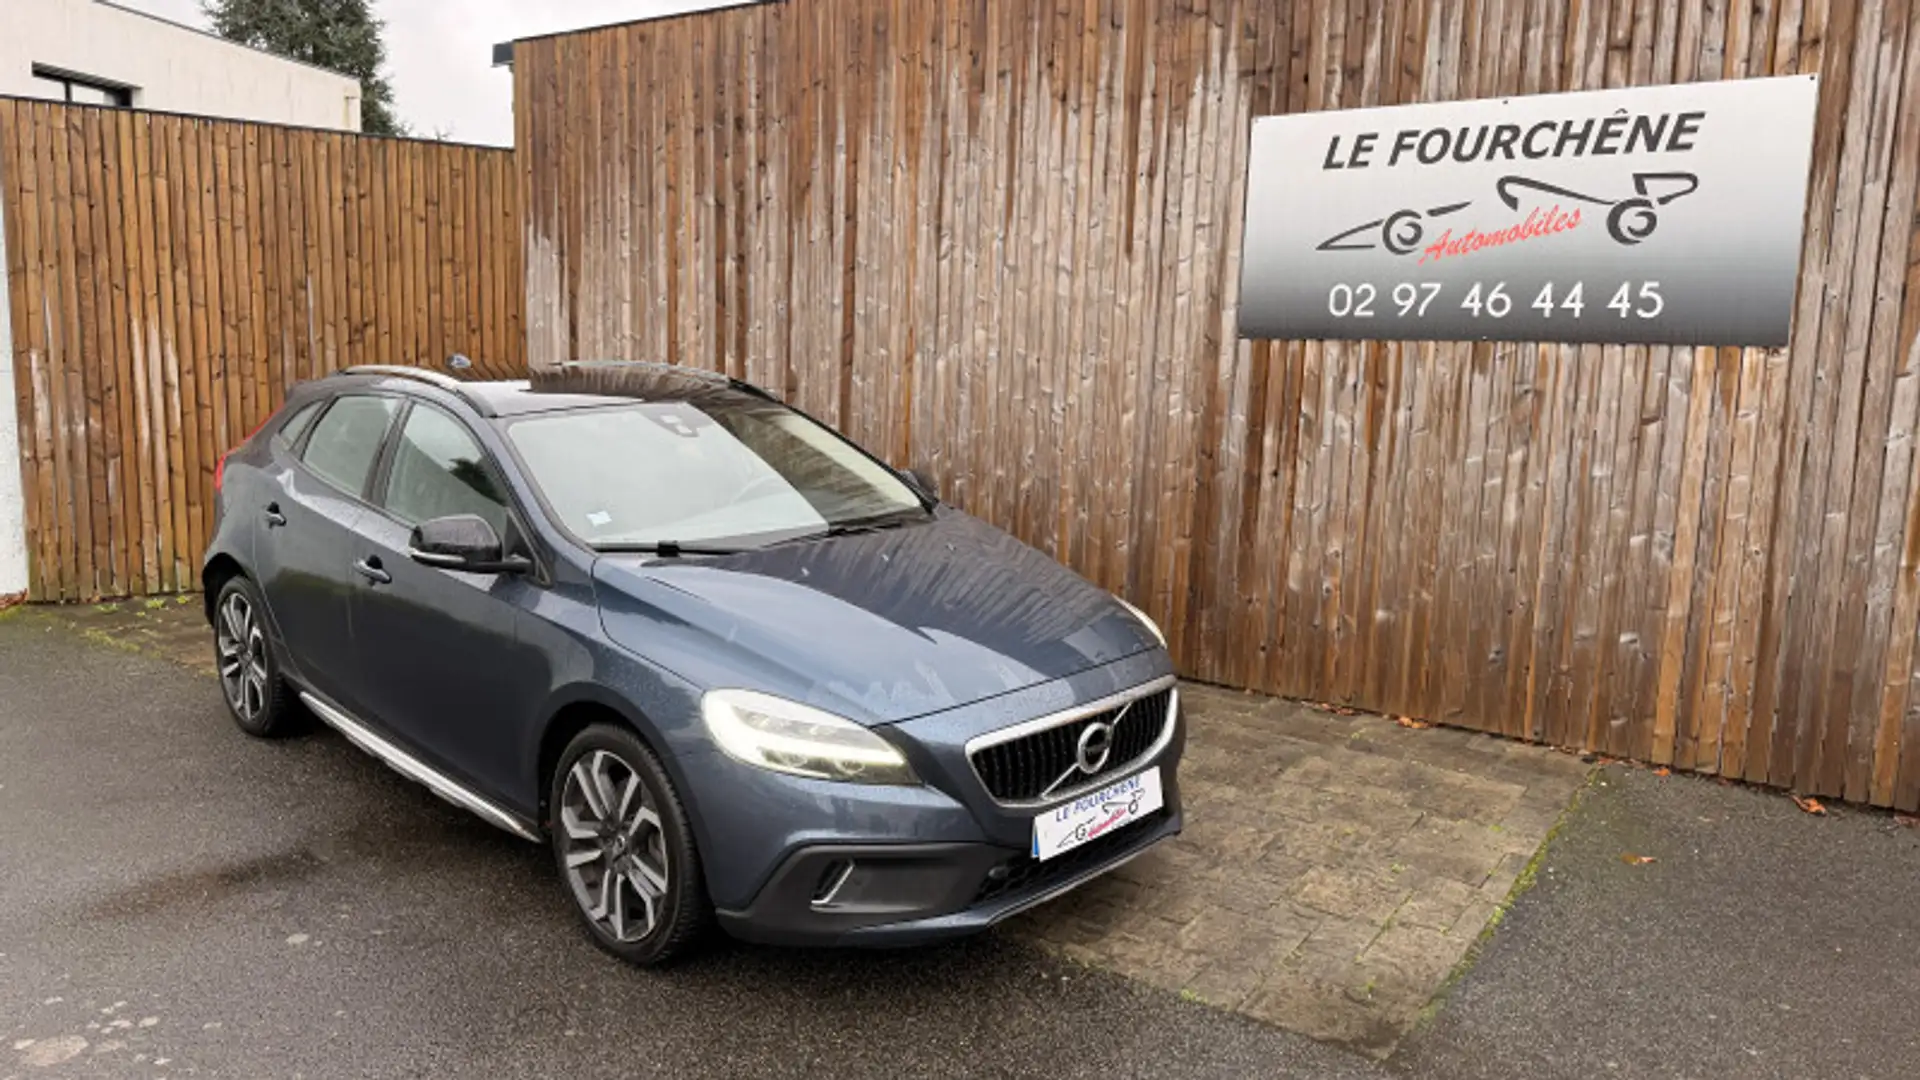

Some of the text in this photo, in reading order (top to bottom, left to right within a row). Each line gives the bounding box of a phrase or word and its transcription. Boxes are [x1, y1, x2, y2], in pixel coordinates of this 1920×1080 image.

[1323, 109, 1706, 170] LE FOURCHÊNE
[1418, 205, 1582, 263] Automobiles
[1329, 281, 1665, 318] 02 97 46 44 45
